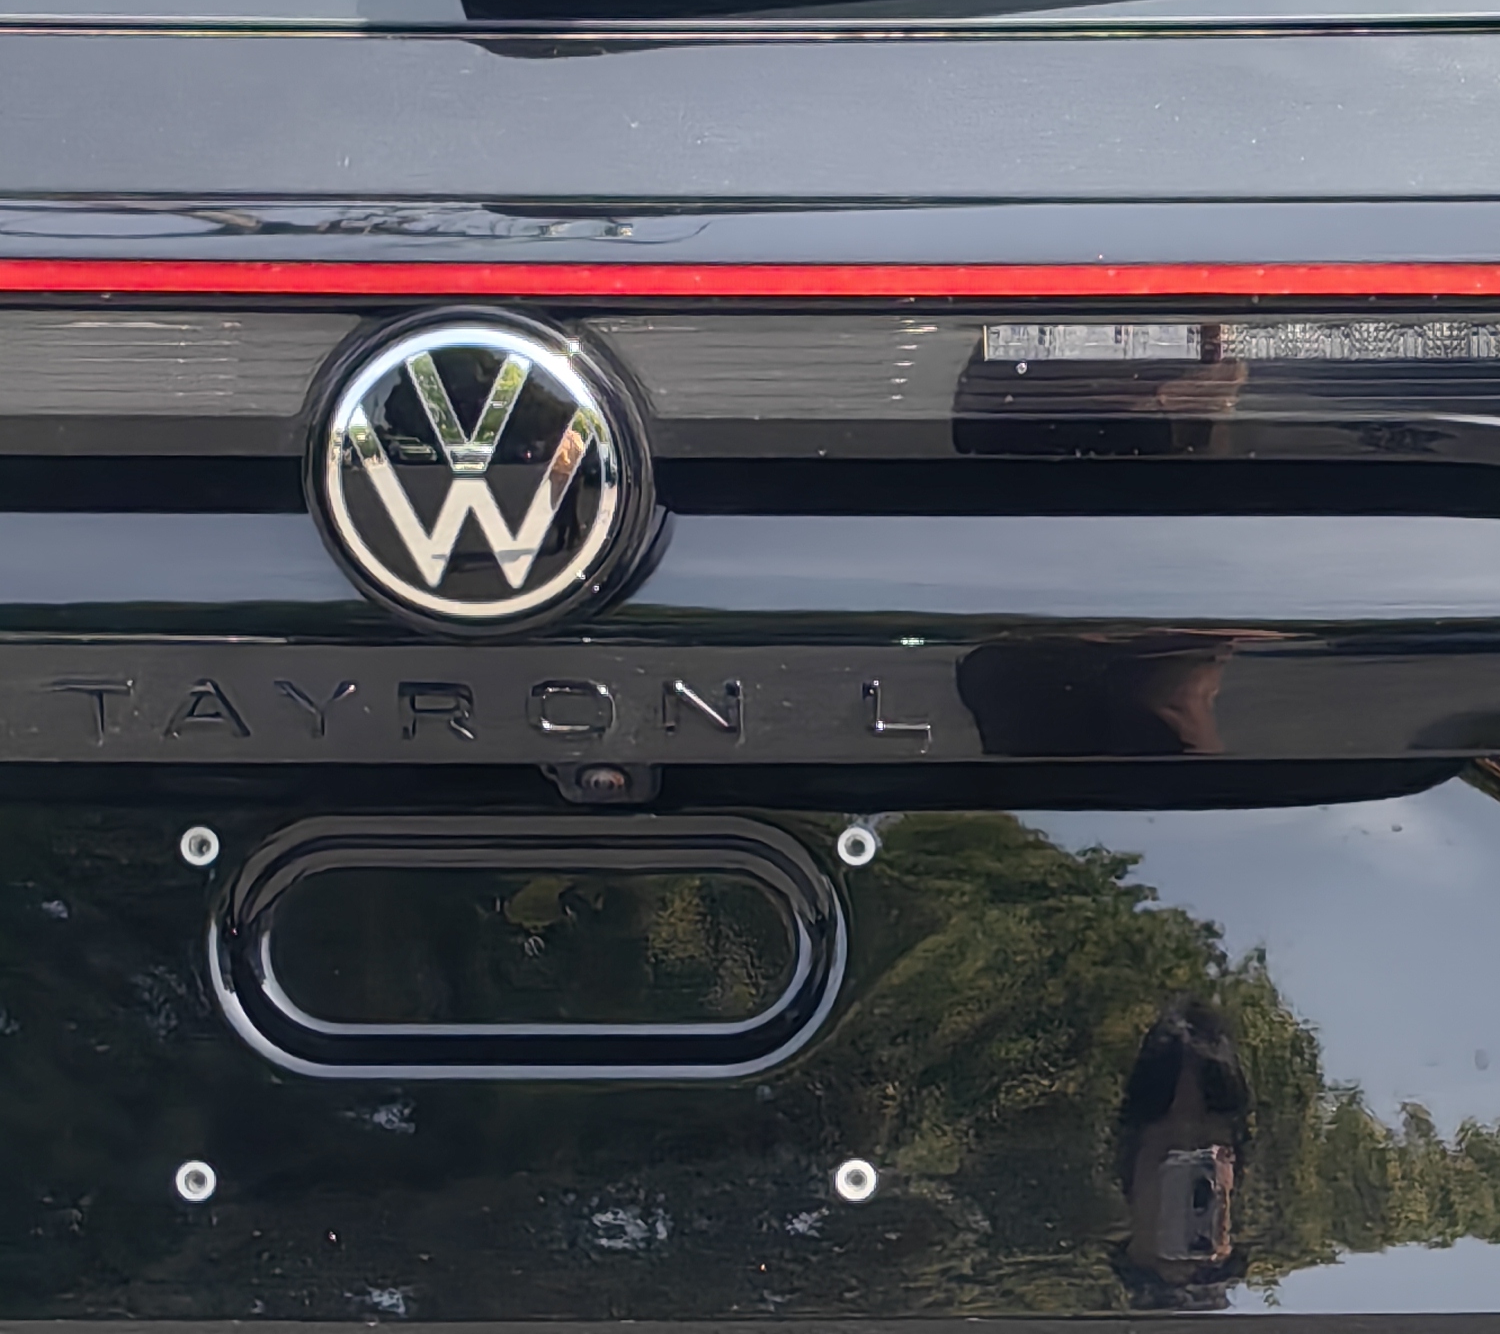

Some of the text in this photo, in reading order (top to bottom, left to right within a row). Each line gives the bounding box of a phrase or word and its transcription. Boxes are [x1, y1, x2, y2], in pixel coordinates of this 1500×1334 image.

[345, 349, 600, 590] VW
[41, 677, 932, 753] TAYRON L
